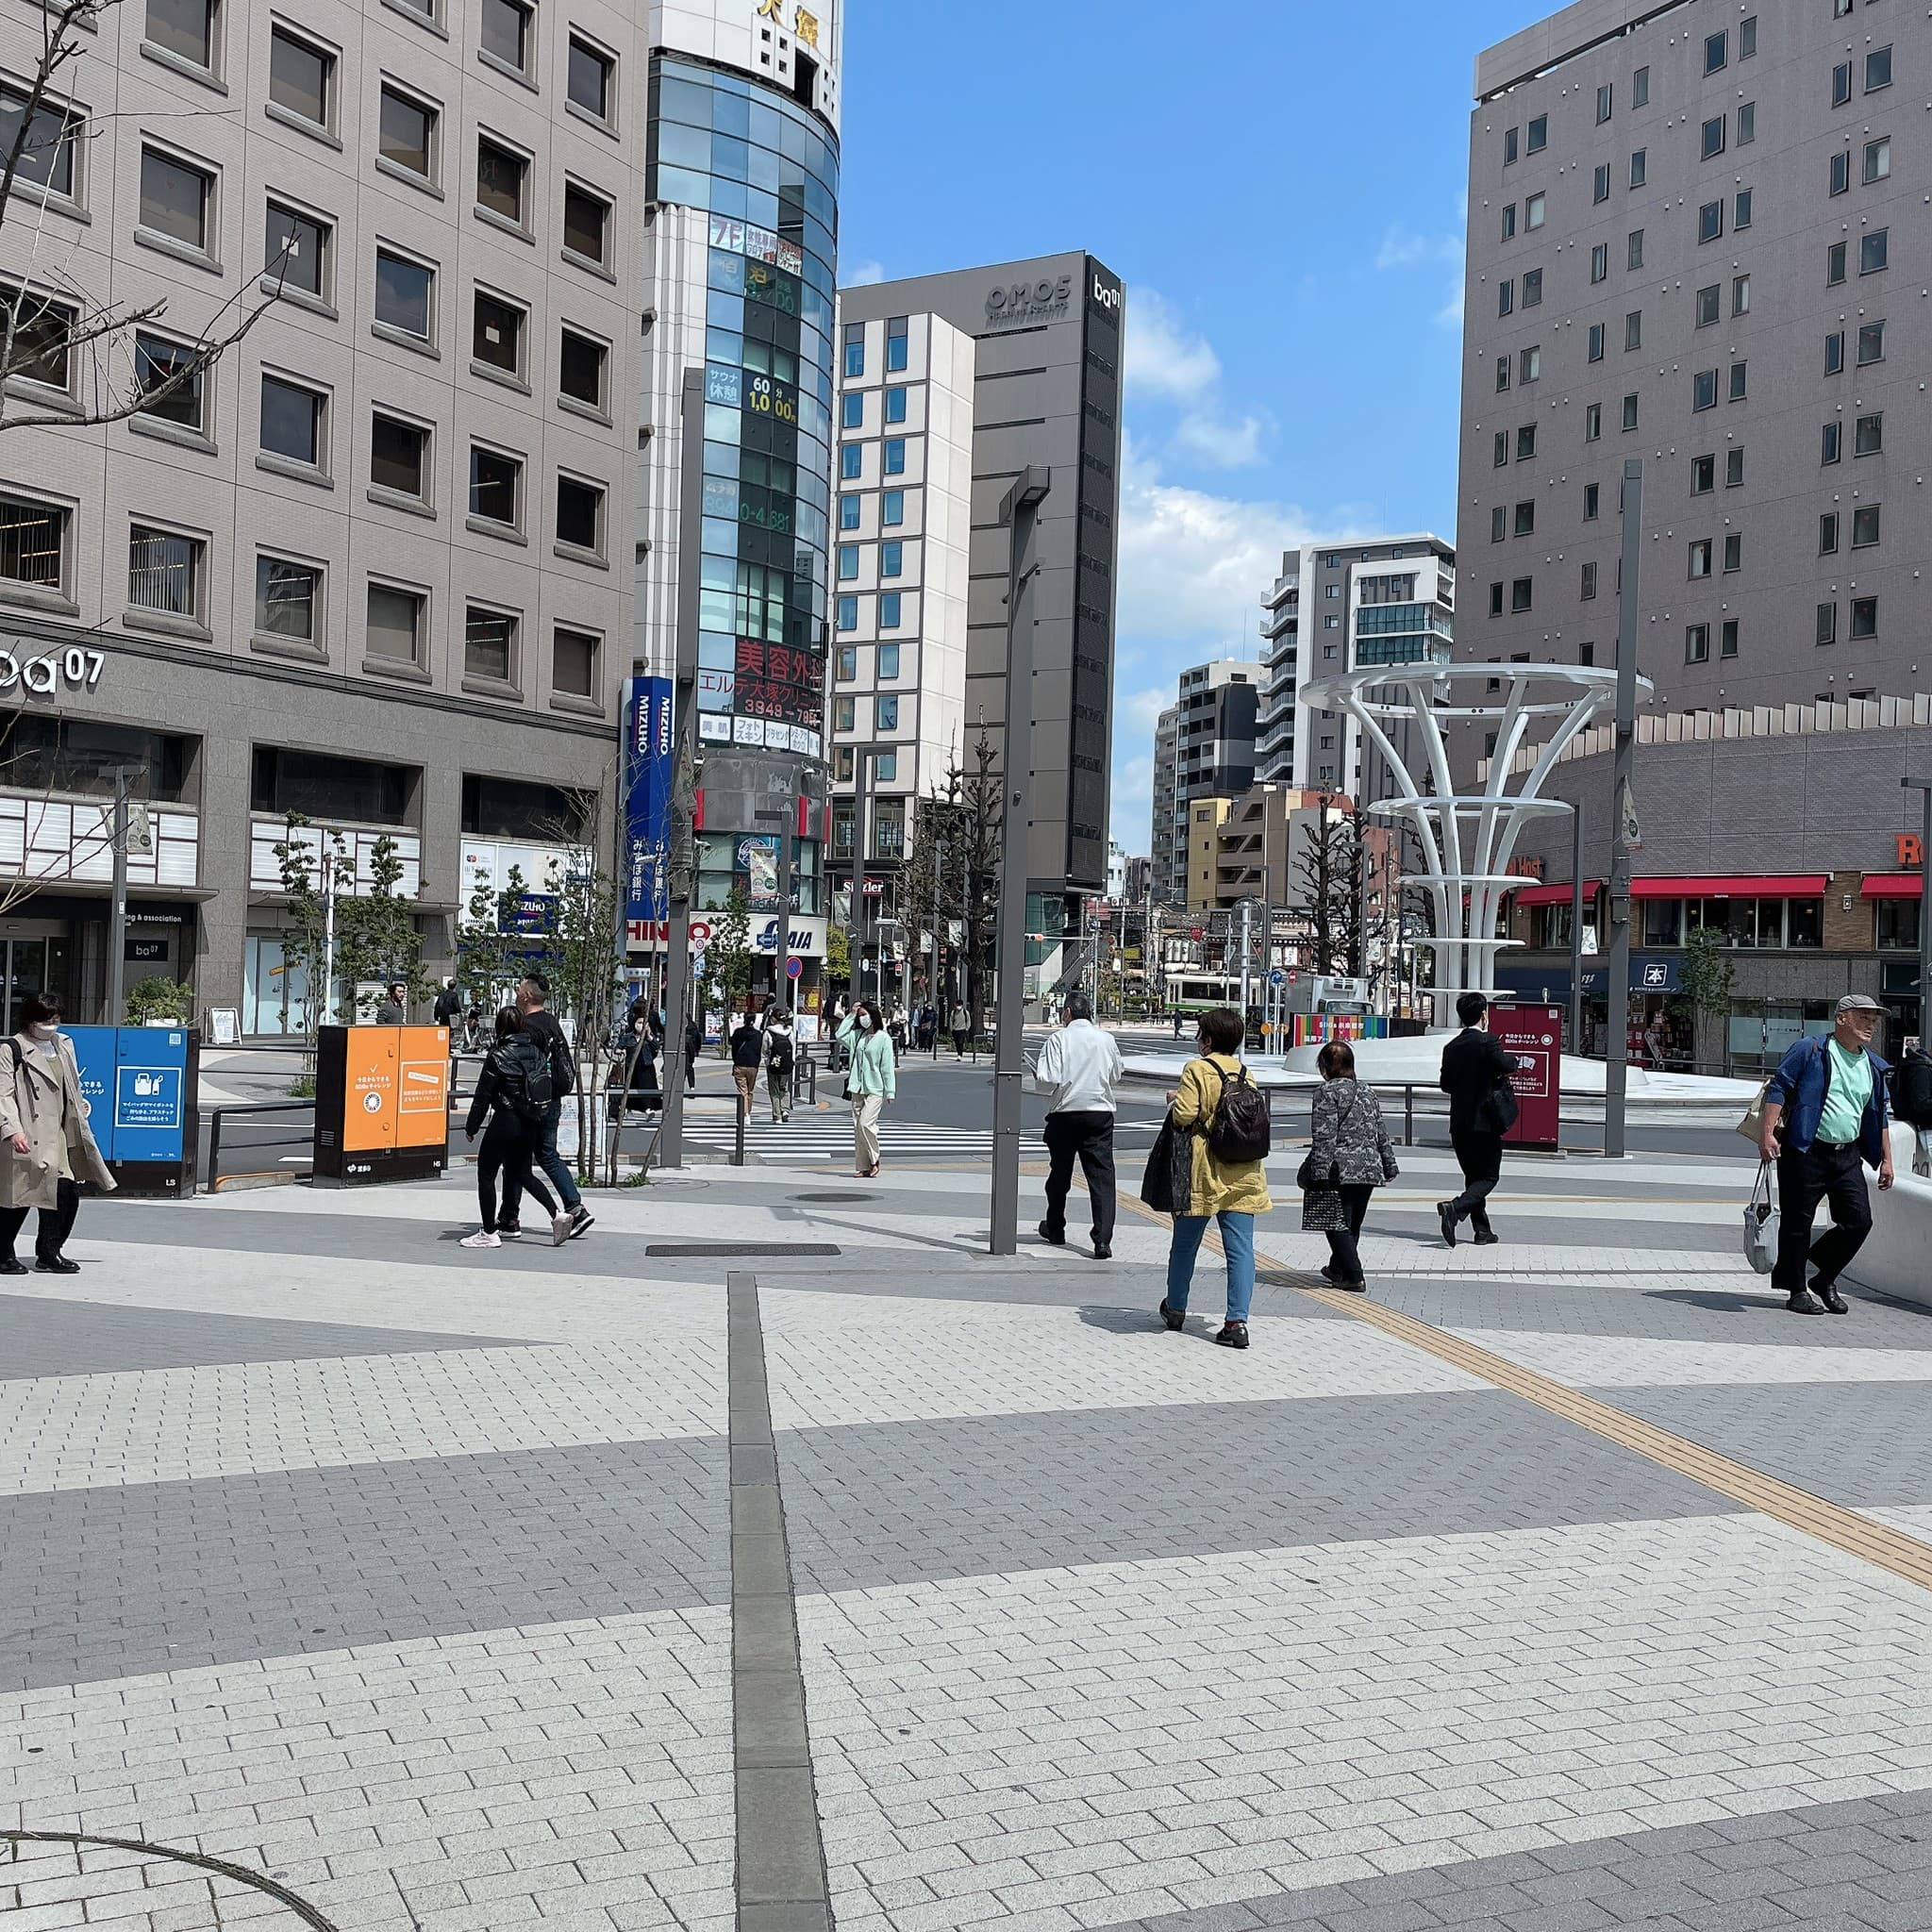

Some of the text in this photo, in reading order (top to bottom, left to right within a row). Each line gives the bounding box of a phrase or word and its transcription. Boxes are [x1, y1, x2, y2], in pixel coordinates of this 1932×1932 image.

[712, 218, 742, 249] 7F
[988, 275, 1072, 309] OMO5
[709, 369, 738, 383] サウナ
[709, 381, 738, 401] 休憩
[638, 695, 650, 754] MIZUHO
[660, 696, 671, 755] MIZUHO
[1894, 834, 1924, 863] R
[842, 881, 884, 892] Sizler
